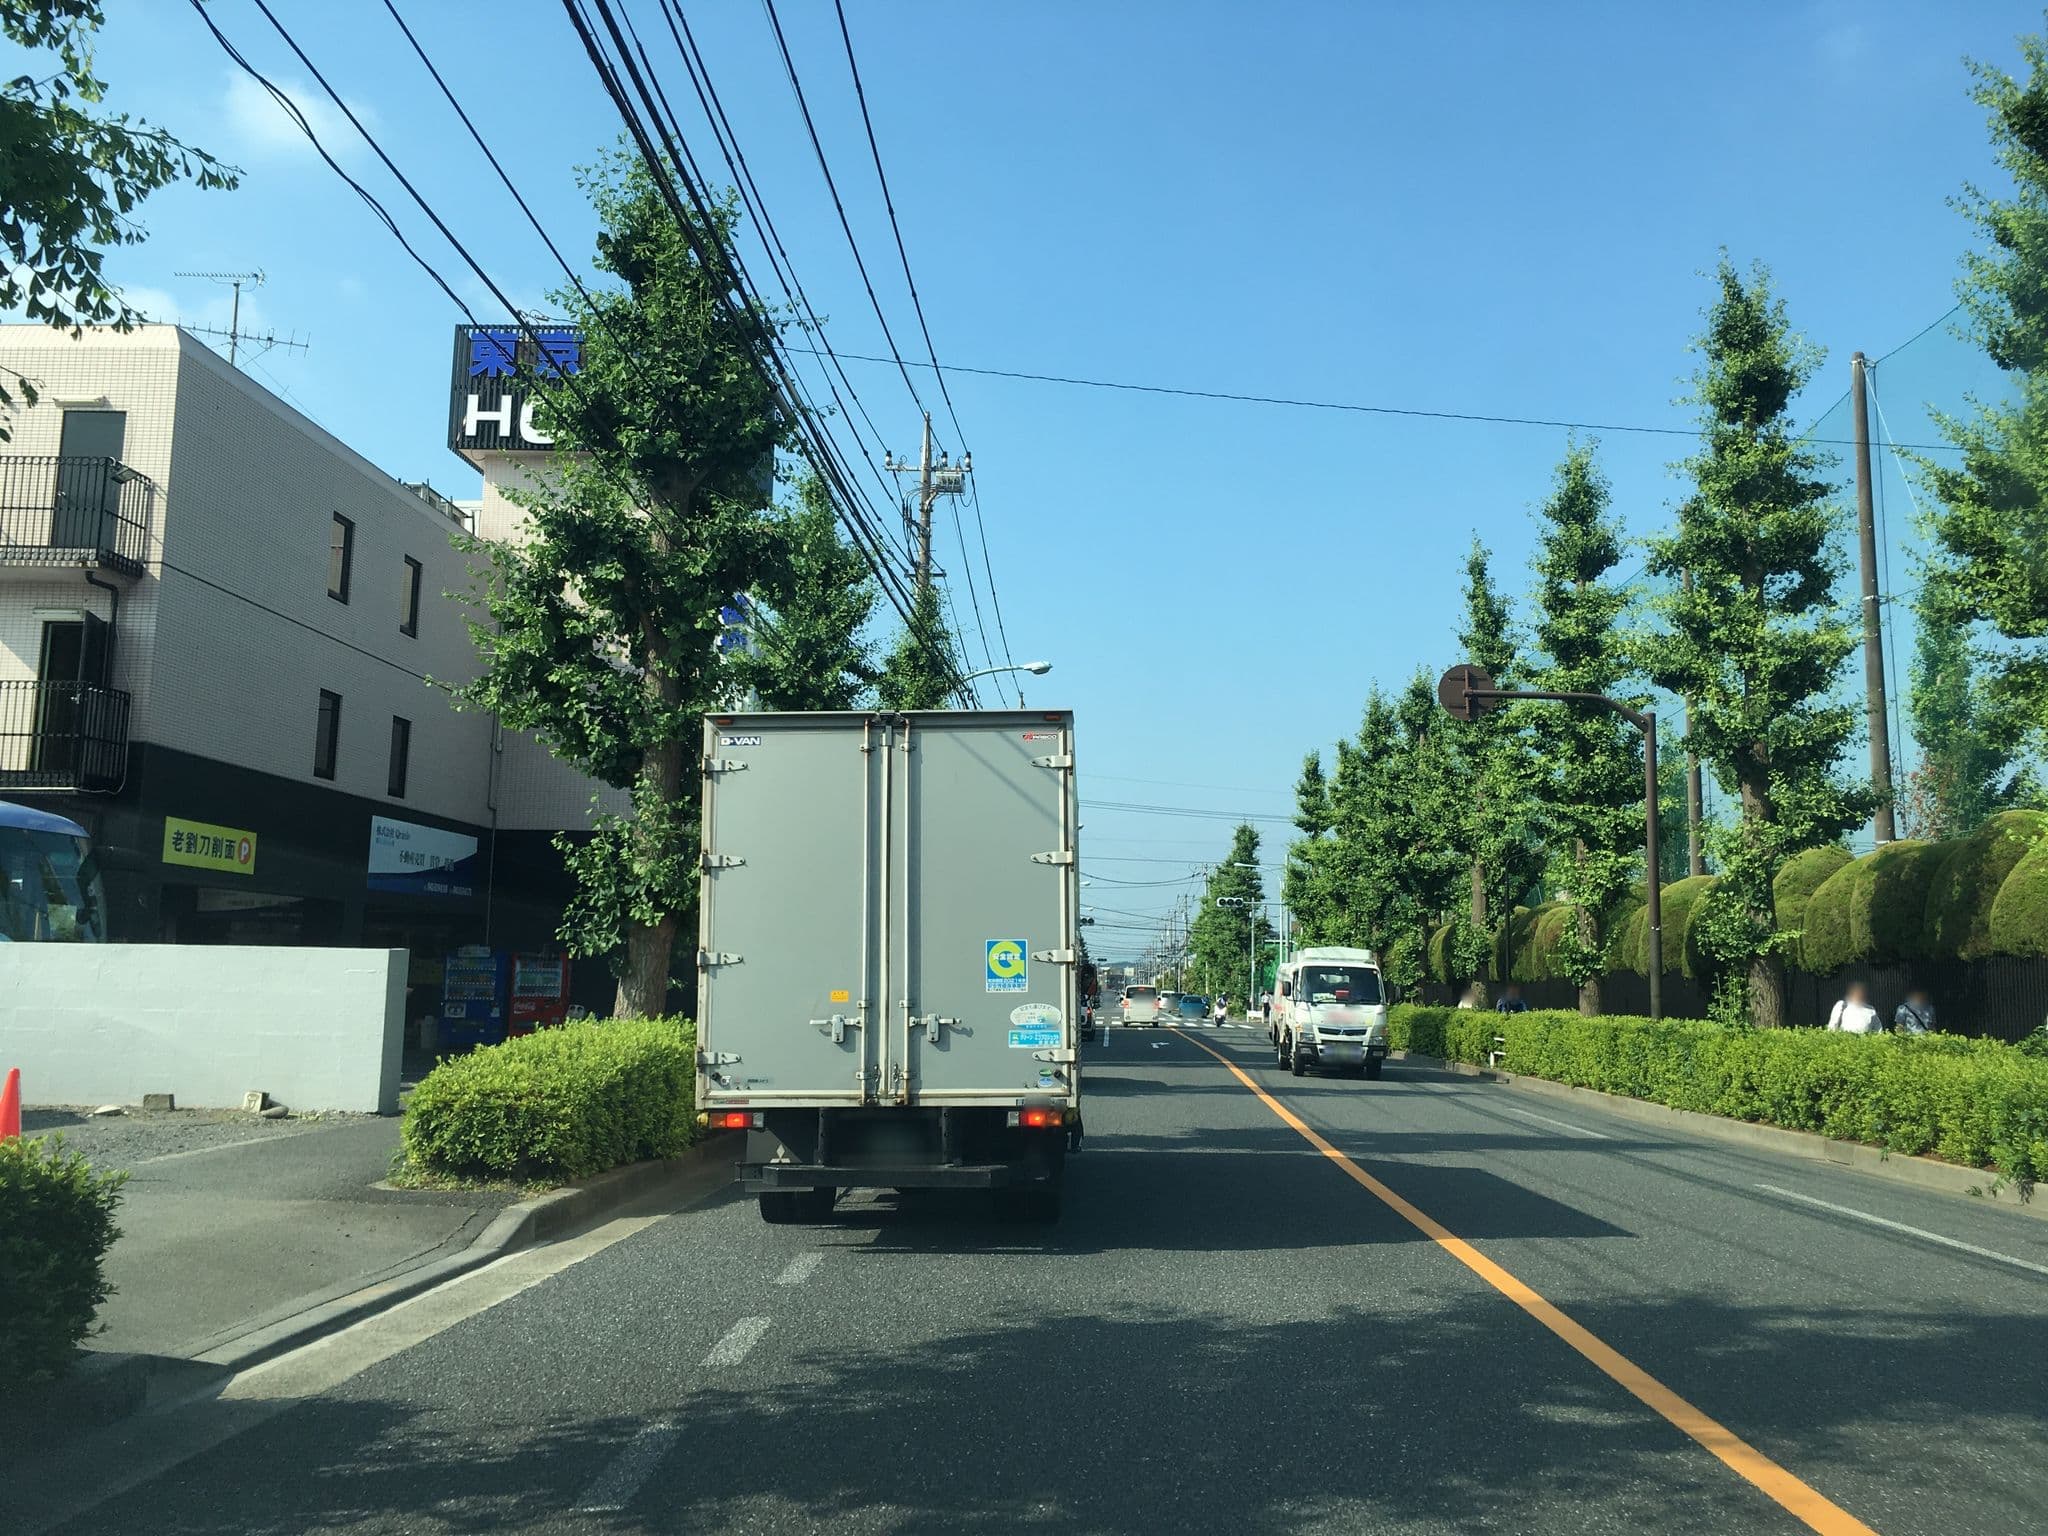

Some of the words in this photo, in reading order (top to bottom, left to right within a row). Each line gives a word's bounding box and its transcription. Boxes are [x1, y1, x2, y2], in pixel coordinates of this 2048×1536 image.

[172, 829, 237, 860] 老劉刀削面
